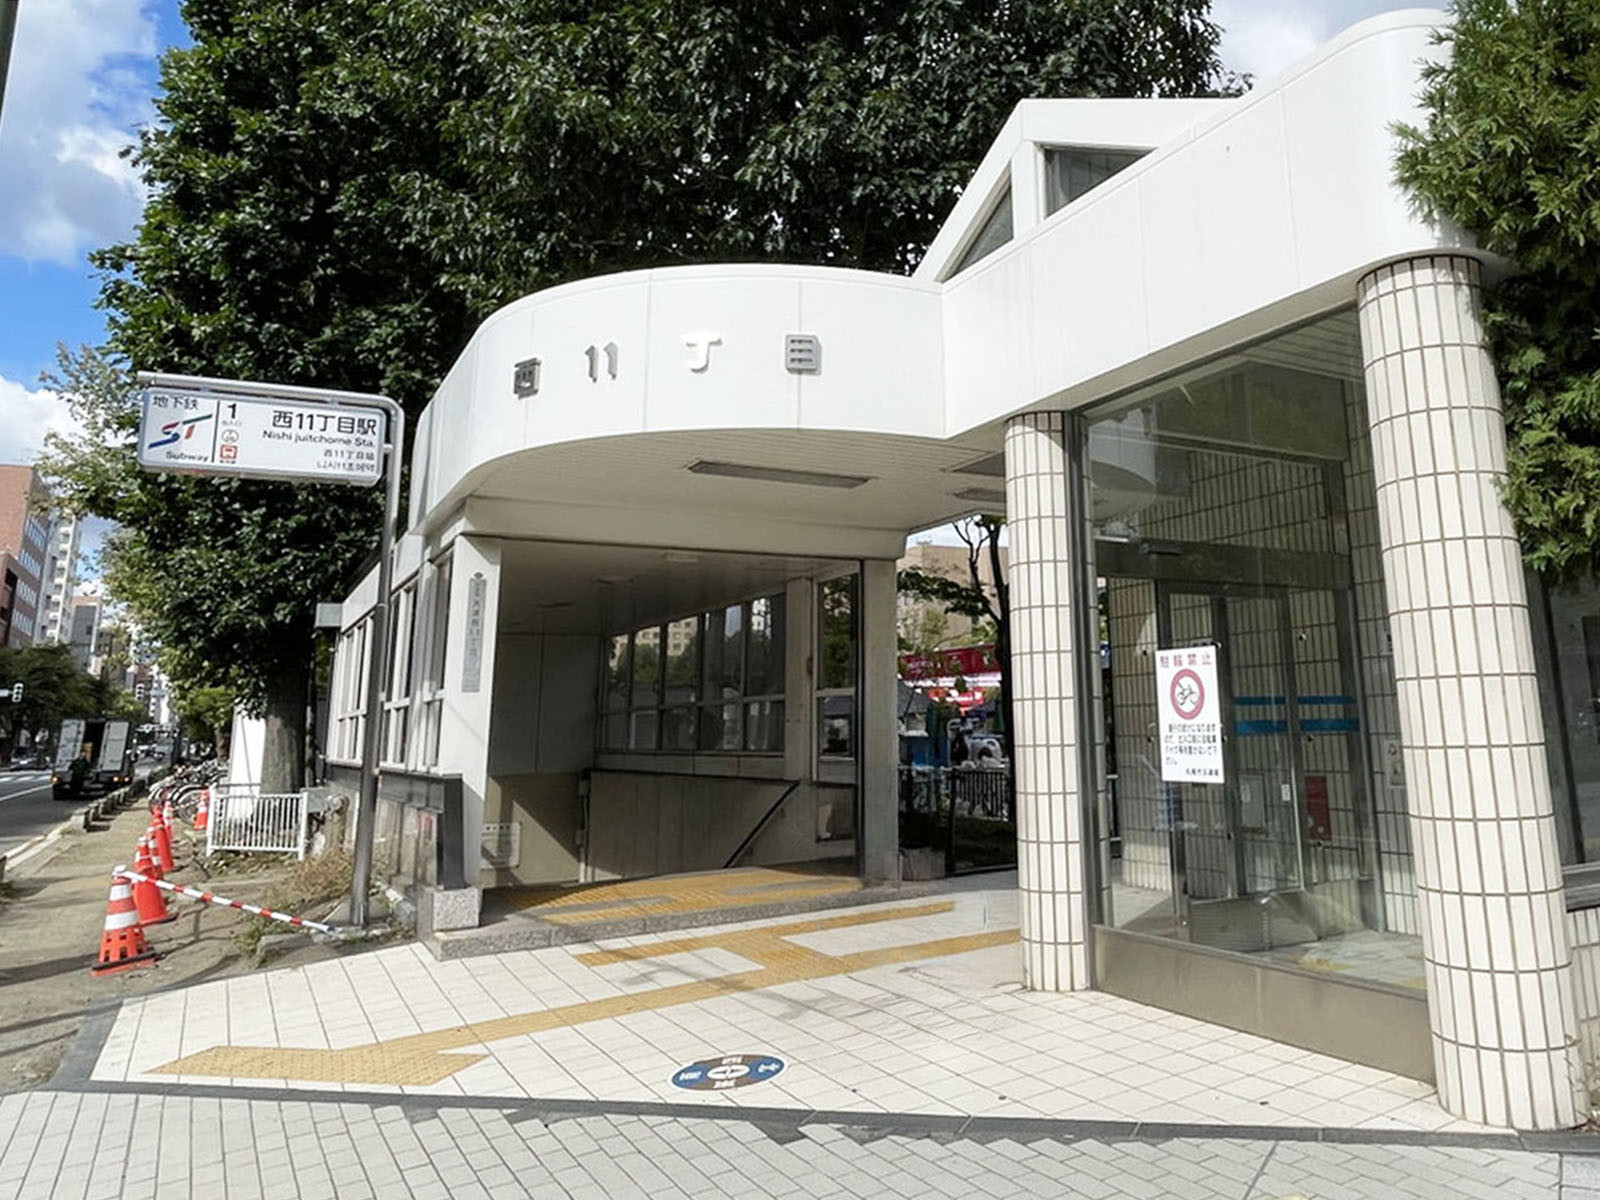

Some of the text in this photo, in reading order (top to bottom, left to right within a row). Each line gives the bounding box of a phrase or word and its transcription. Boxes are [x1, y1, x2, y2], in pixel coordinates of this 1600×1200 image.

[513, 334, 823, 399] 西11丁目
[153, 395, 198, 410] 地下鉄
[227, 403, 237, 419] 1
[272, 410, 377, 435] 西11丁目駅
[262, 429, 293, 440] Nishi
[354, 437, 375, 448] Sta.
[165, 451, 209, 462] Subway
